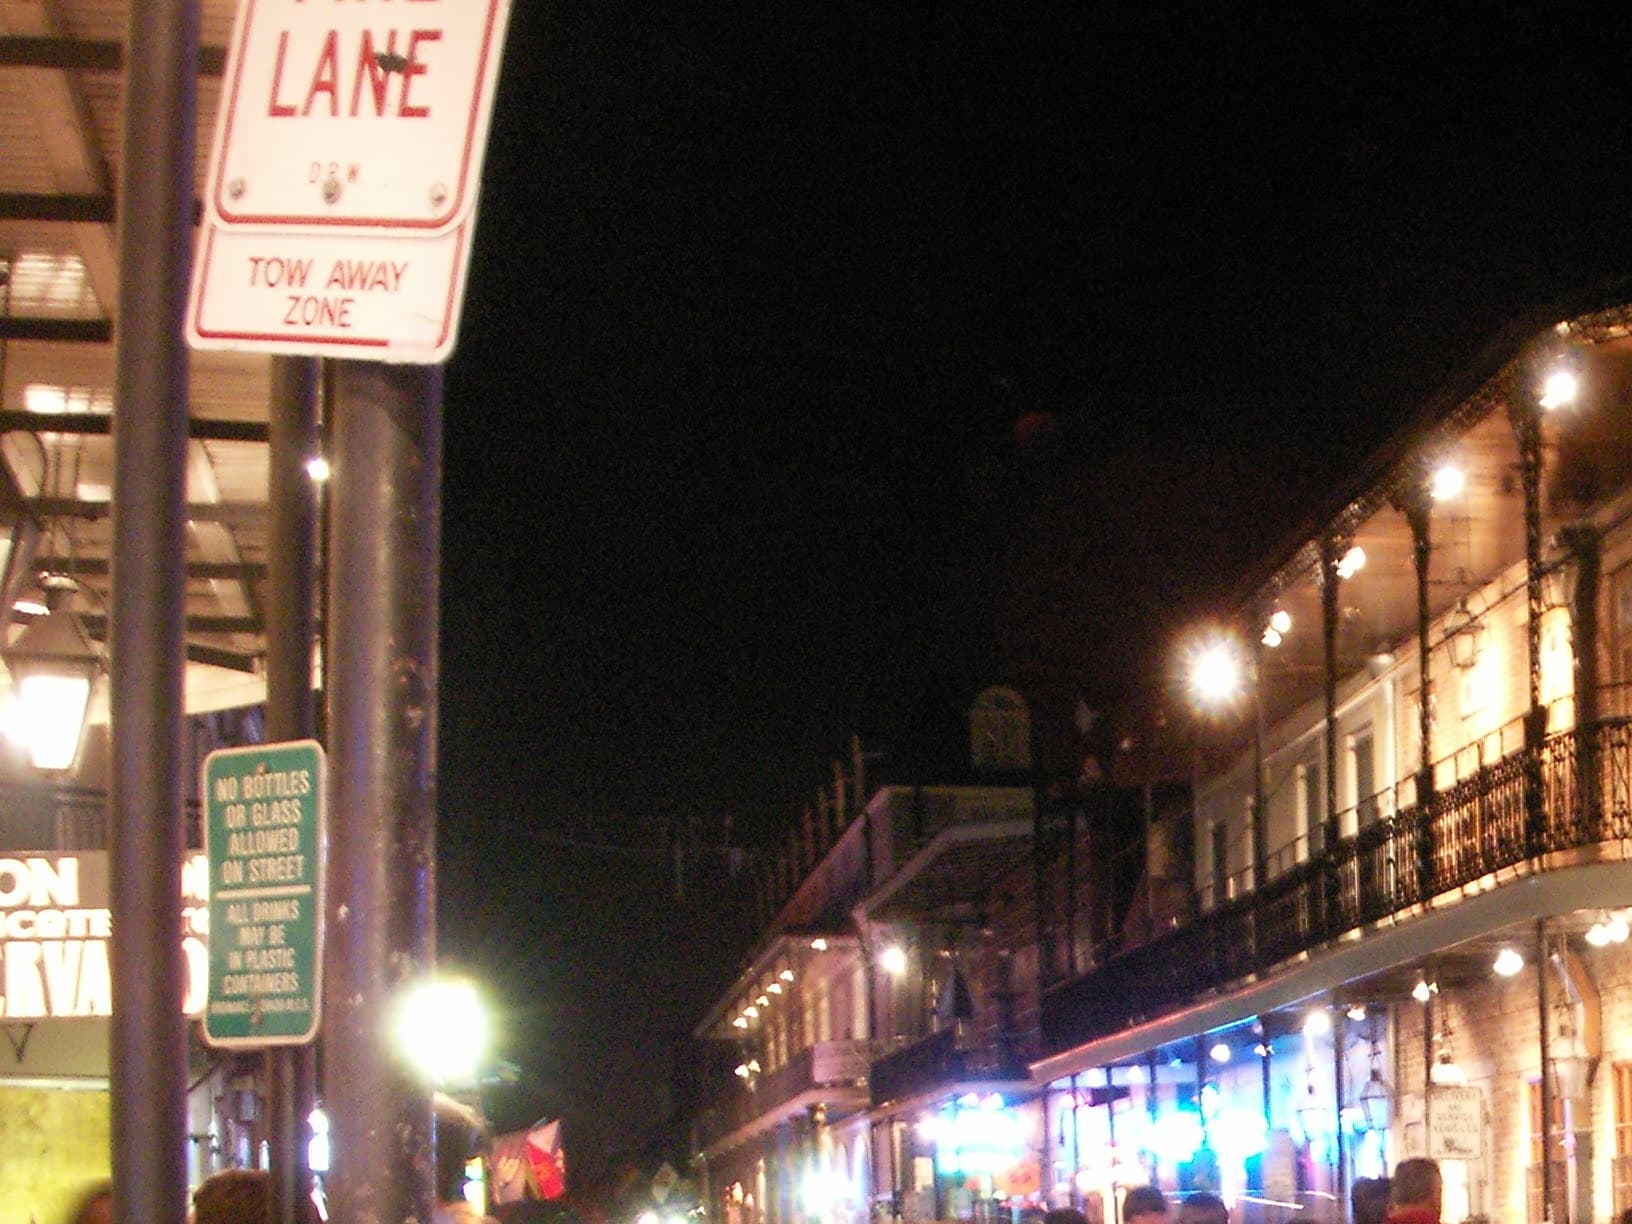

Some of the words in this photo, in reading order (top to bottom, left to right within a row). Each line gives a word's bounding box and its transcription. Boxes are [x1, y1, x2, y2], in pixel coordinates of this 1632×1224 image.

[267, 28, 444, 117] LANE
[248, 256, 314, 287] TOW
[325, 259, 408, 292] AWAY
[283, 295, 355, 327] ZONE
[215, 776, 238, 801] NO
[242, 769, 311, 799] BOTTLES
[226, 804, 246, 828] OR
[252, 799, 302, 826] GLASS
[229, 827, 299, 855] ALLOWED
[222, 860, 243, 883] ON
[248, 855, 304, 881] STREET
[246, 947, 295, 969] PLASTIC
[223, 972, 299, 994] CONTAINERS
